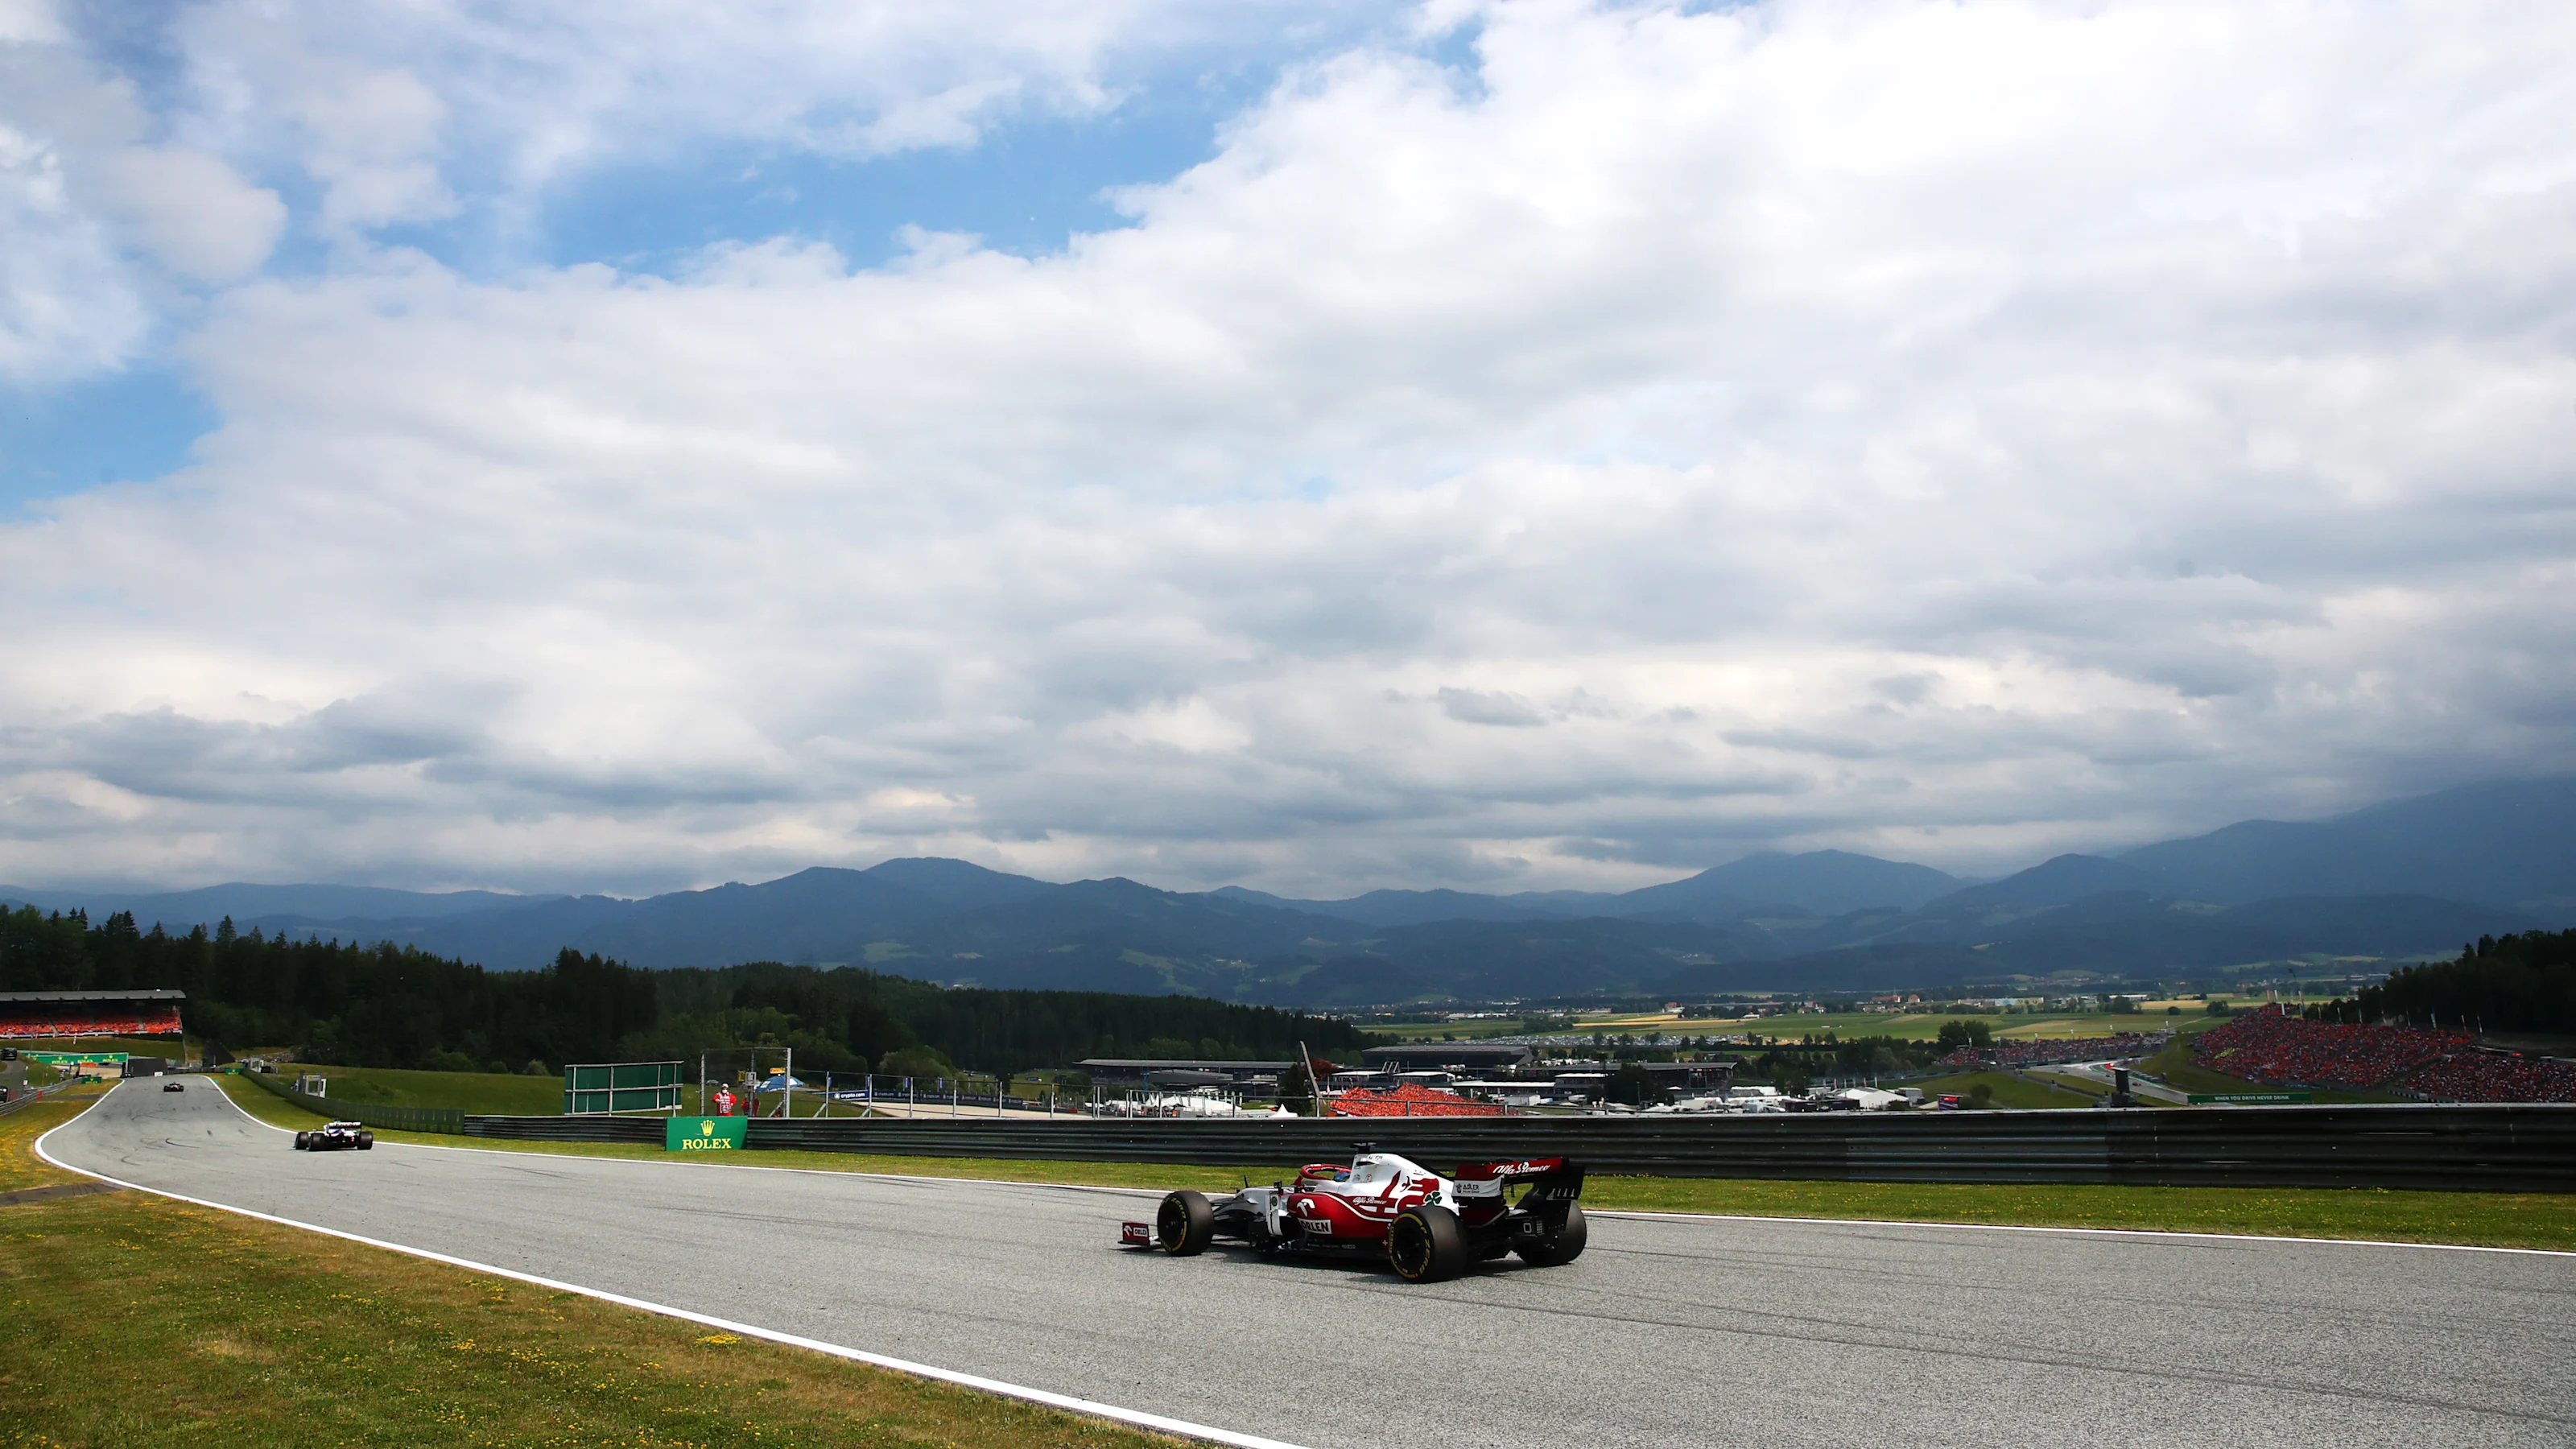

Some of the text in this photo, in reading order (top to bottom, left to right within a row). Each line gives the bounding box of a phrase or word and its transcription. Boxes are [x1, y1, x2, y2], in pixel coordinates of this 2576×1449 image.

[682, 1138, 732, 1150] ROLEX
[1492, 1162, 1551, 1174] Alfa Romeo
[1300, 1220, 1330, 1232] ORLEN
